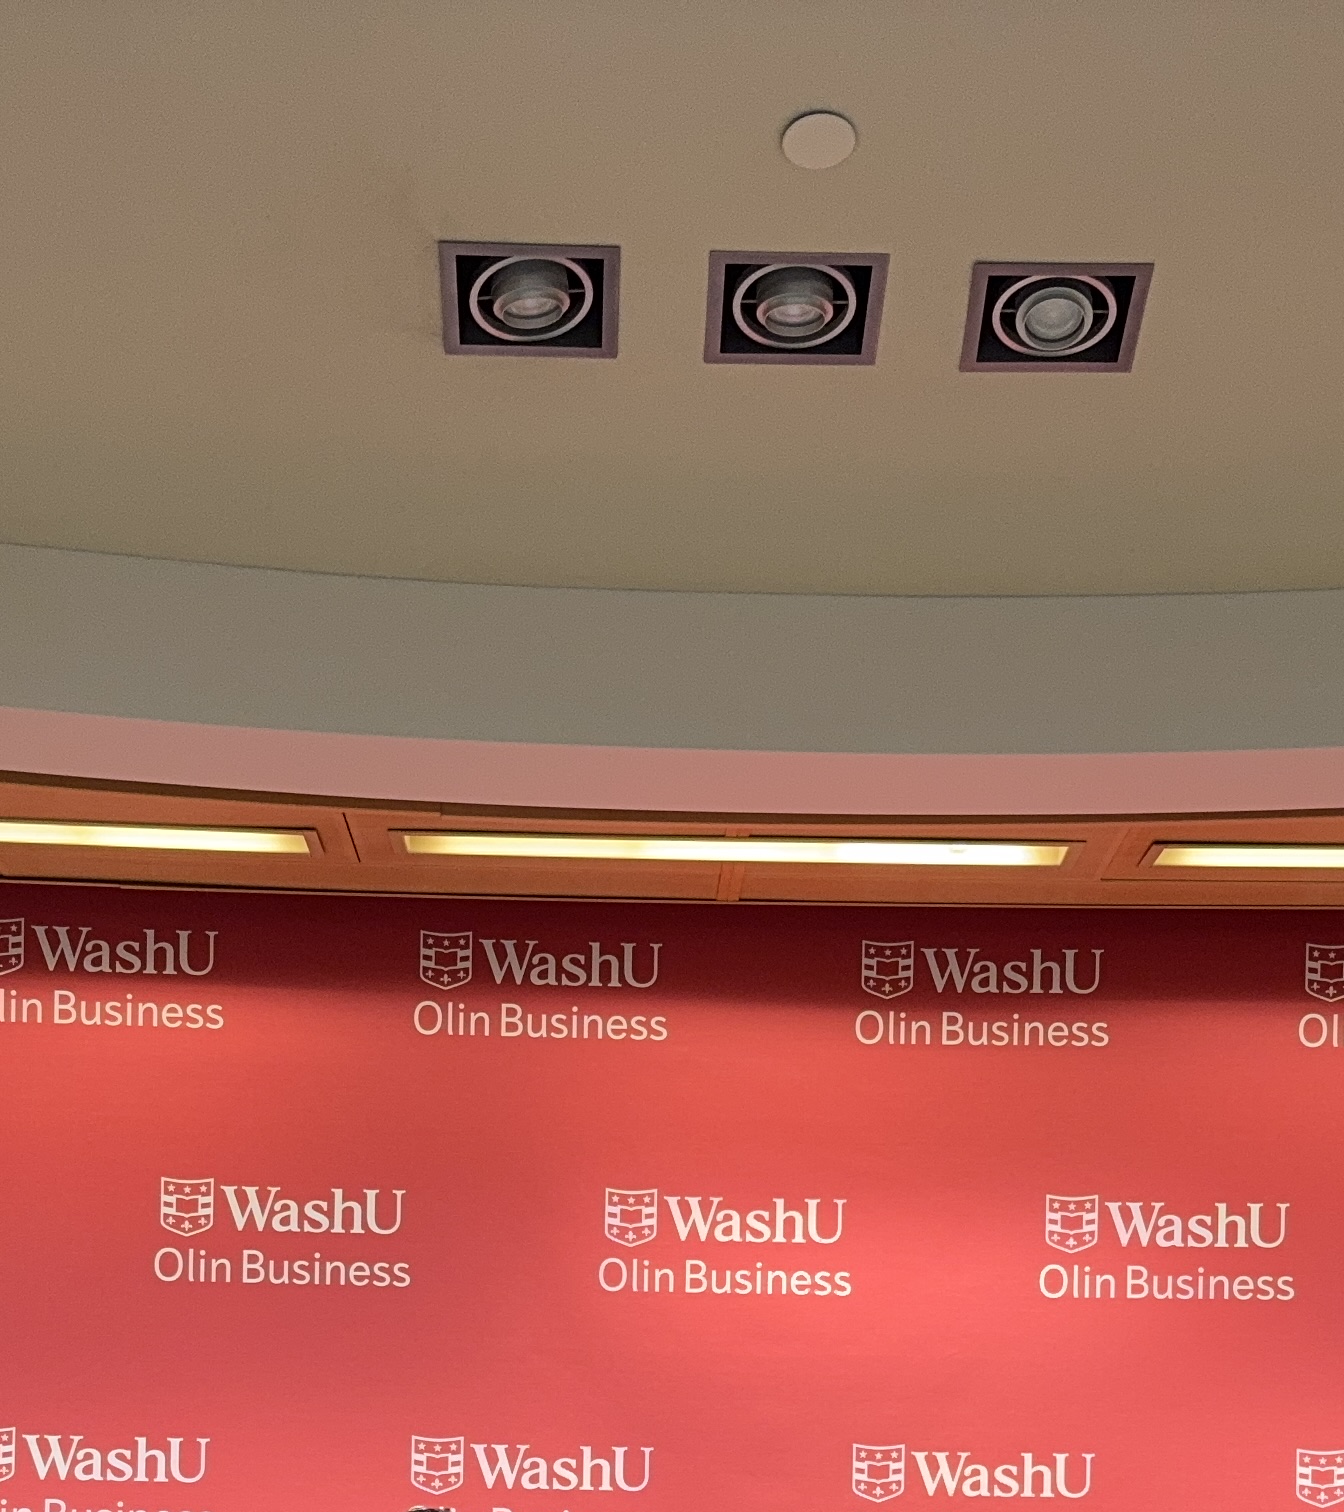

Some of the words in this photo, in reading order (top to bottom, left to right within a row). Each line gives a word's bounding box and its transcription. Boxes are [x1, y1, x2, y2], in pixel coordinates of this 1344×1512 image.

[30, 924, 219, 976] WashU
[478, 938, 663, 989] WashU
[920, 947, 1105, 995] WashU
[53, 989, 225, 1030] Business
[413, 1000, 490, 1037] Olin
[500, 1002, 668, 1041] Business
[855, 1009, 931, 1045] Olin
[941, 1011, 1109, 1047] Business
[219, 1184, 407, 1235] WashU
[666, 1196, 848, 1245] WashU
[1104, 1201, 1291, 1249] WashU
[153, 1247, 232, 1283] Olin
[242, 1249, 411, 1288] Business
[598, 1257, 675, 1293] Olin
[684, 1259, 852, 1297] Business
[1038, 1263, 1116, 1299] Olin
[1126, 1264, 1295, 1301] Business
[21, 1433, 211, 1484] WashU
[469, 1443, 655, 1492] WashU
[910, 1451, 1096, 1499] WashU
